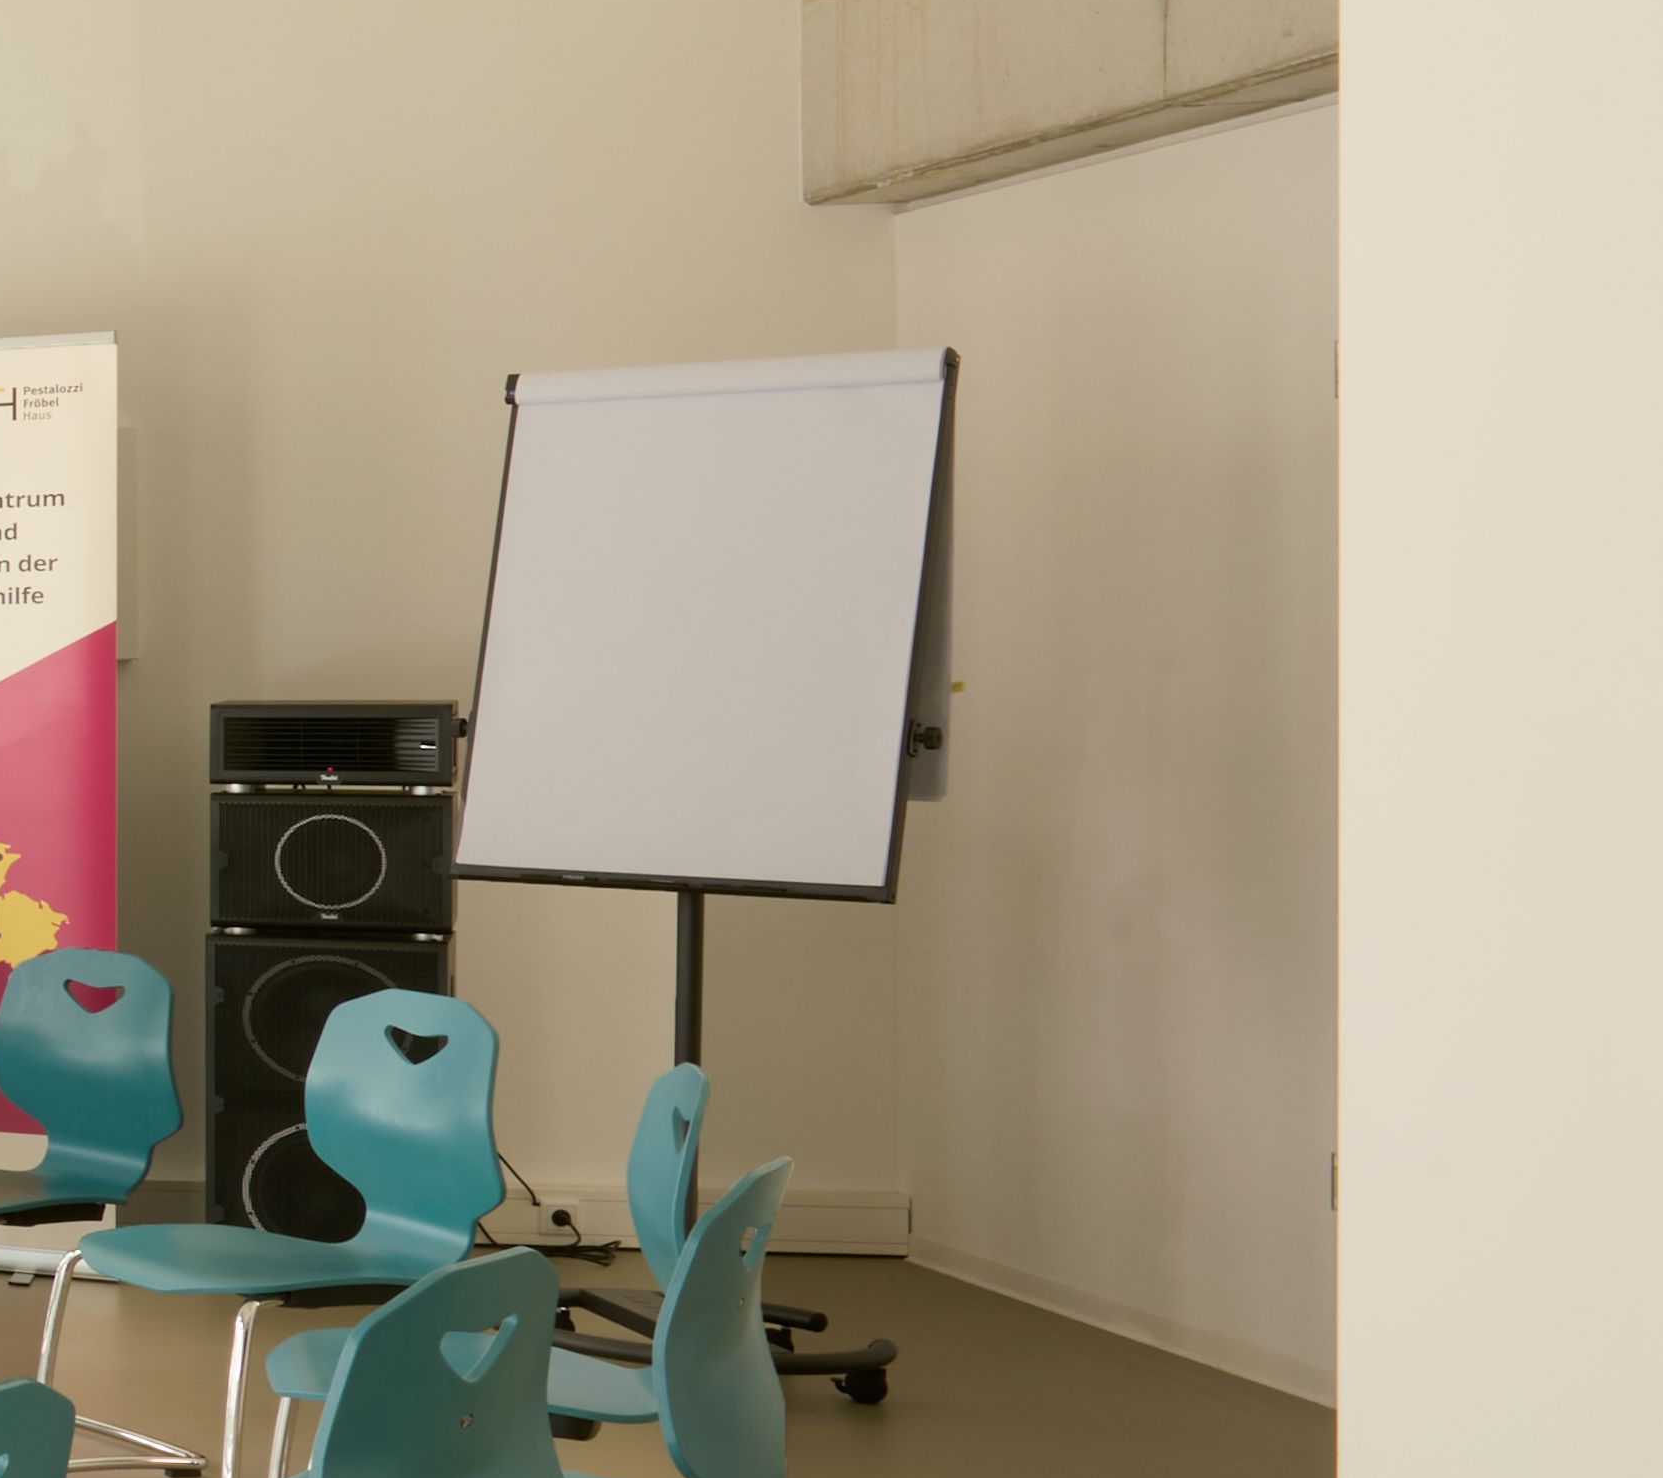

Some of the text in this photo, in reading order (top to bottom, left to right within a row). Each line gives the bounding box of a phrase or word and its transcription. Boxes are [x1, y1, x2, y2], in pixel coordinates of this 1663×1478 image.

[22, 382, 84, 396] Pestalozzi
[22, 396, 60, 409] Fröbel
[22, 410, 52, 420] Haus
[17, 553, 59, 573] der
